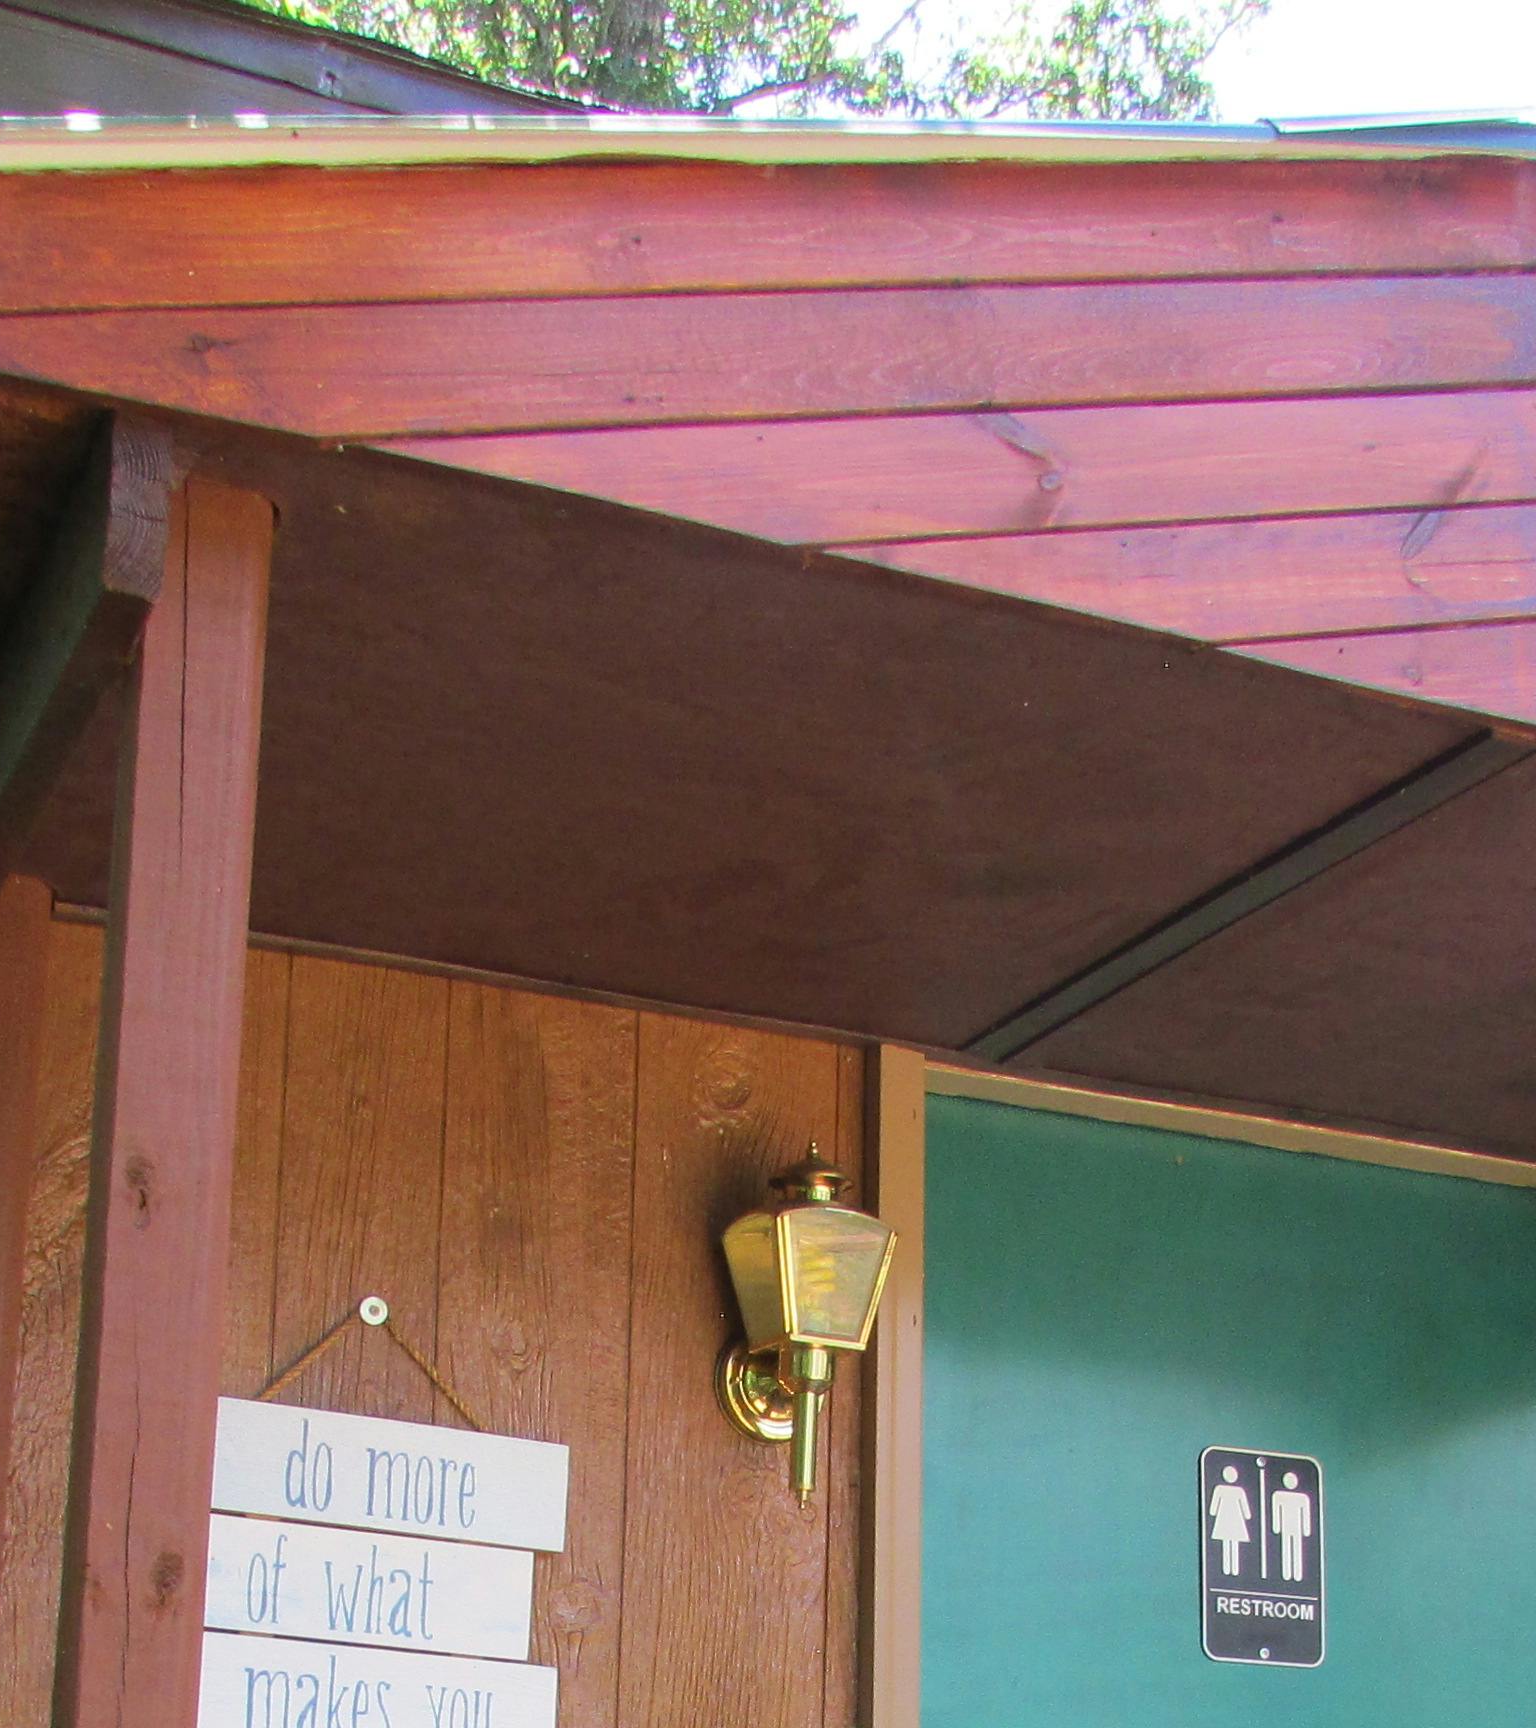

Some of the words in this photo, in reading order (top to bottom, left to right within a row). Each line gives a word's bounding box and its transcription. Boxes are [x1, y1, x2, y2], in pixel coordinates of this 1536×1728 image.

[284, 1418, 333, 1512] do
[366, 1446, 477, 1529] more
[247, 1533, 288, 1624] of
[324, 1544, 434, 1640] what
[1216, 1596, 1314, 1621] RESTROOM
